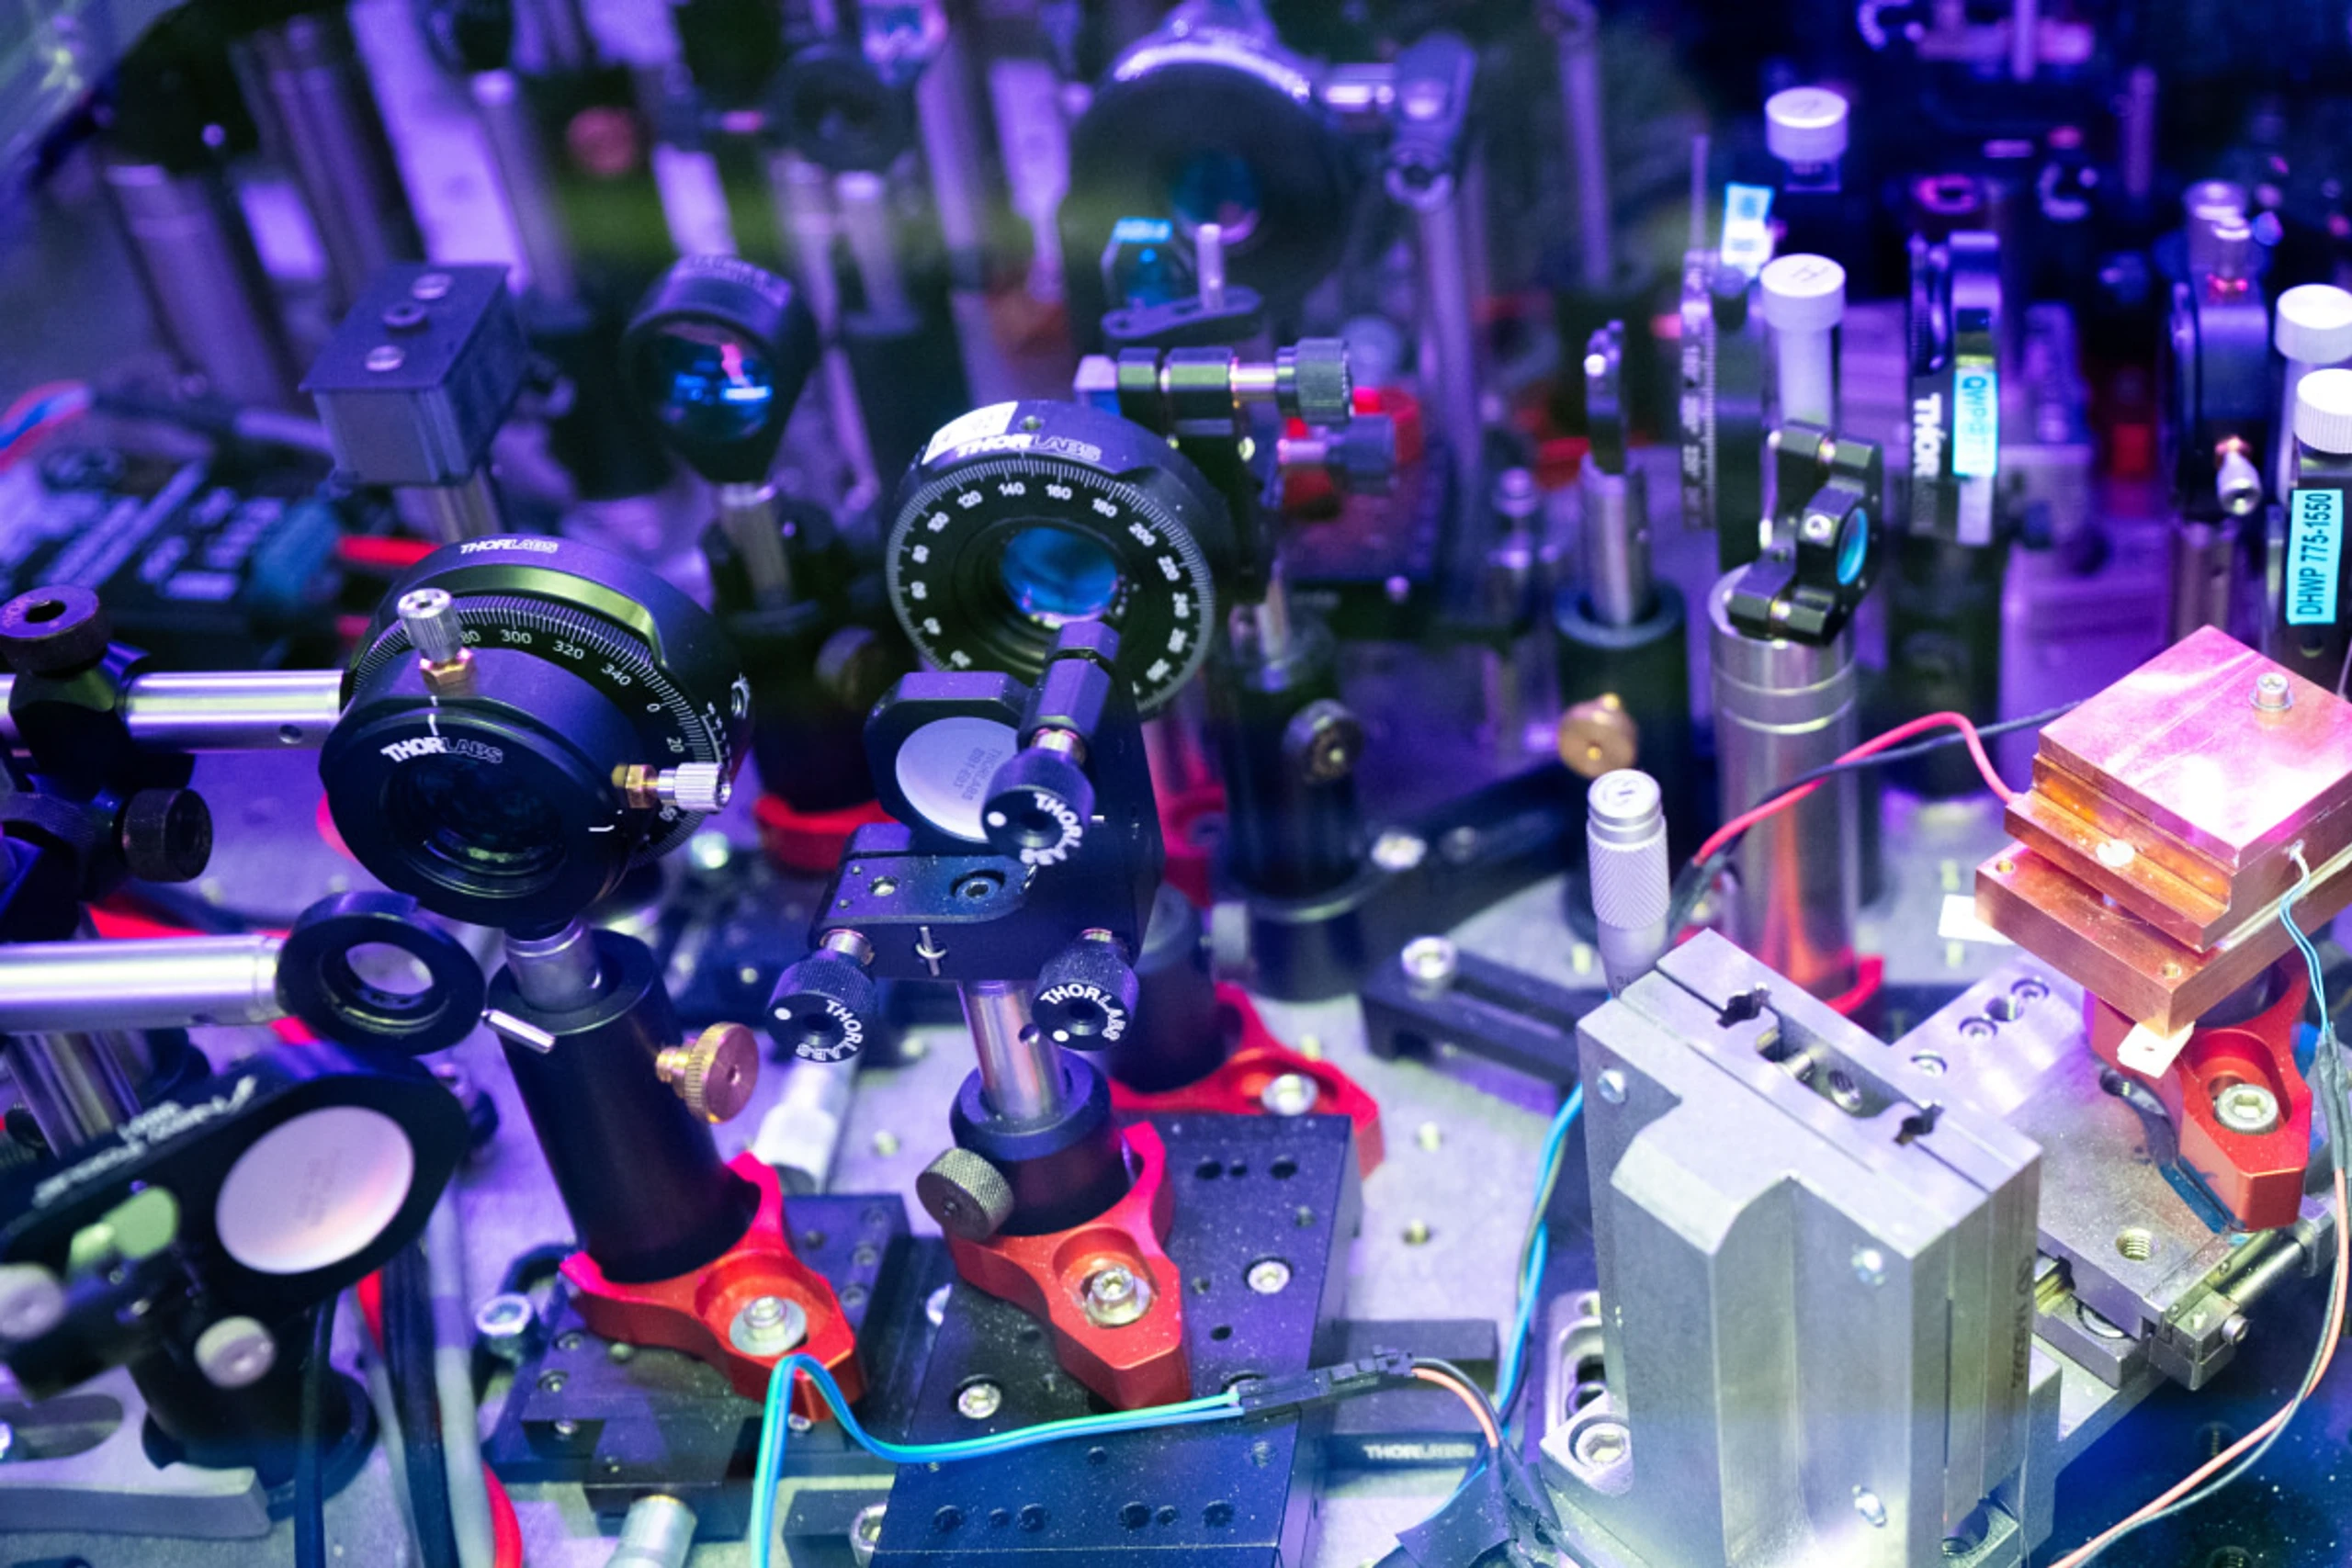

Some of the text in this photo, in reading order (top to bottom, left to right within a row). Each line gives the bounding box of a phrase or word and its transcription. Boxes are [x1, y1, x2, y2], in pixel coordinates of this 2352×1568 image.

[956, 433, 1102, 462] THORLABS
[927, 511, 950, 533] 100
[957, 490, 983, 509] 120
[998, 481, 1025, 496] 140
[1046, 483, 1072, 501] 160
[1091, 497, 1118, 518] 180
[1128, 522, 1157, 547] 200
[460, 538, 559, 555] THORLABS
[2295, 492, 2333, 615] DHWP 775-1550
[459, 629, 481, 644] 80
[501, 628, 532, 644] 300
[552, 640, 584, 660] 320
[600, 663, 632, 686] 340
[646, 703, 662, 713] 0
[666, 737, 685, 753] 20
[379, 737, 503, 763] THORLABS
[1020, 792, 1083, 865] THORLABS
[796, 998, 864, 1062] THORLABS
[1039, 983, 1126, 1041] THORLABS
